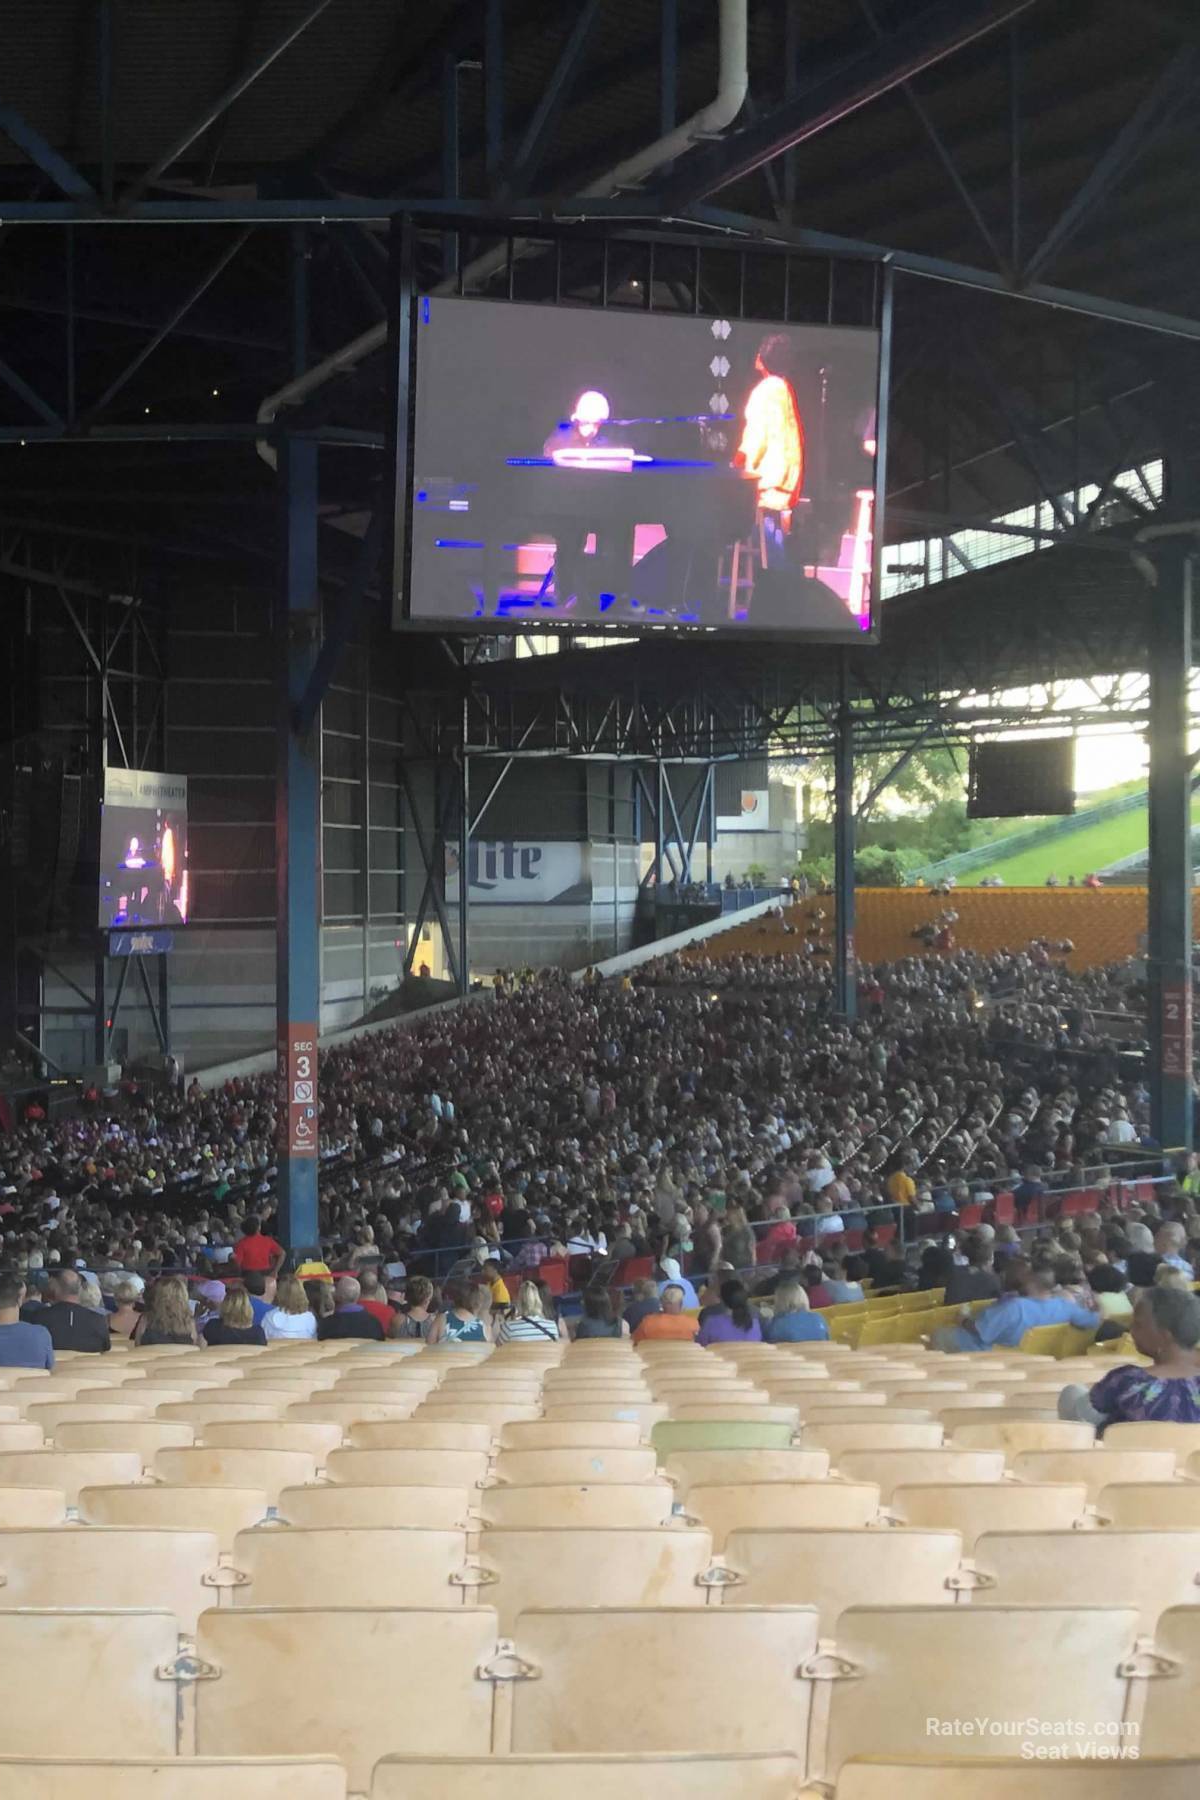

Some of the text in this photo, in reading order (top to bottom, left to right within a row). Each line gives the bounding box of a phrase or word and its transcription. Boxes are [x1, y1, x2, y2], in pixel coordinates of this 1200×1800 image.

[467, 841, 542, 889] Lite
[1165, 1003, 1179, 1020] 2
[293, 1041, 313, 1052] SEC
[296, 1055, 311, 1078] 3
